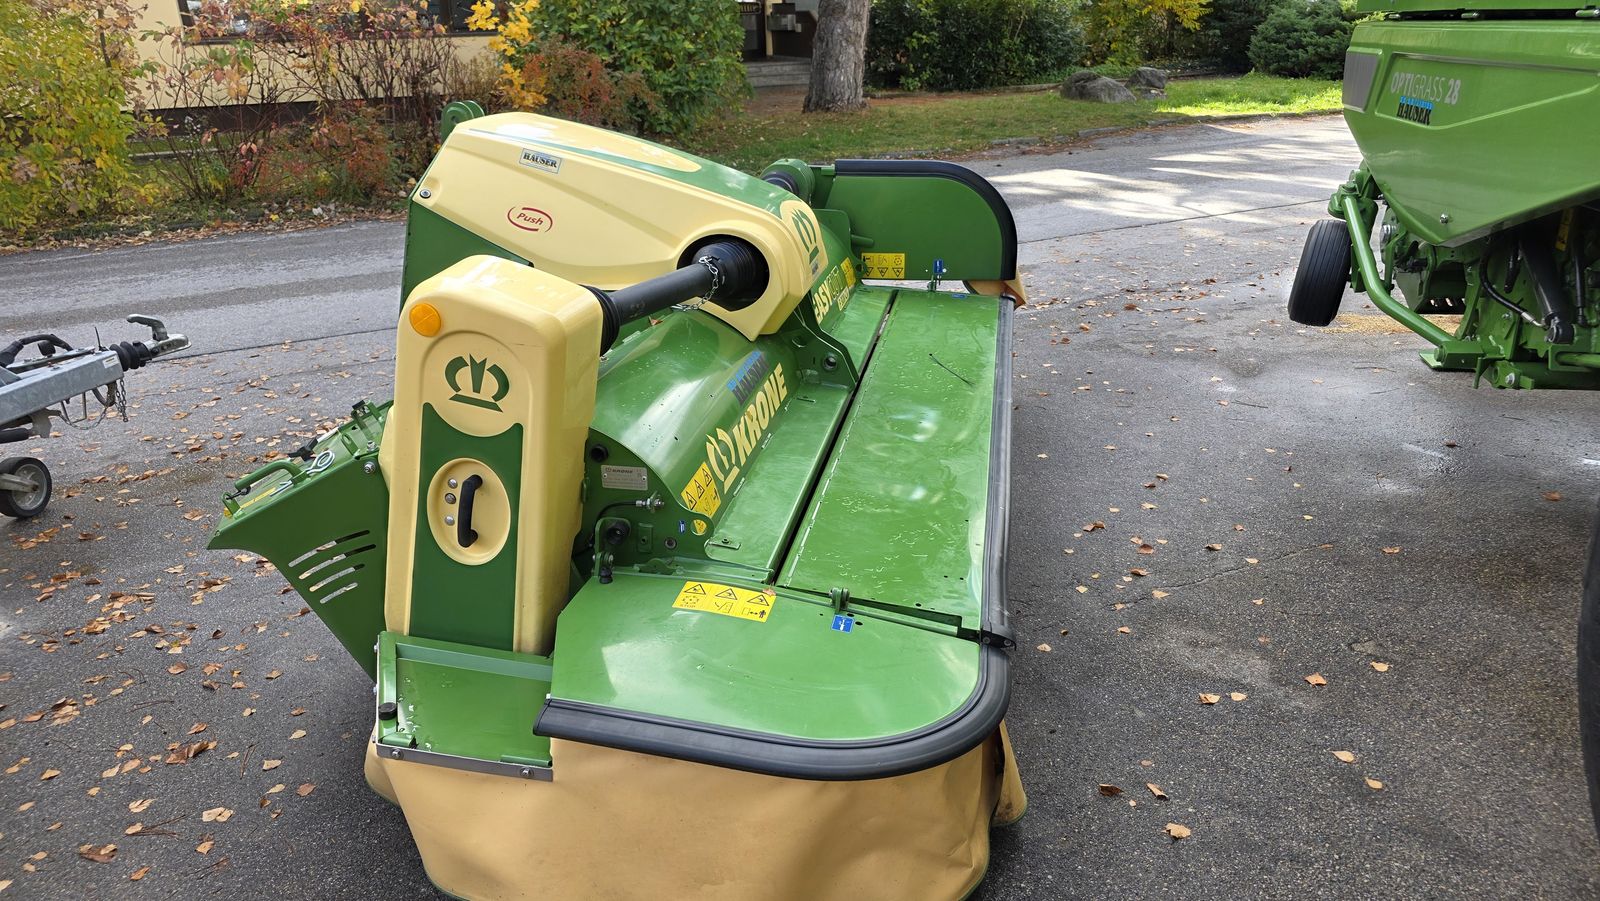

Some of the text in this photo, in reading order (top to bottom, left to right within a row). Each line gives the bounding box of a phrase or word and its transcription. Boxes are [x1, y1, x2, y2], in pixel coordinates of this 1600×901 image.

[1390, 72, 1446, 102] OPTIGRASS
[1443, 78, 1461, 105] 28
[523, 152, 558, 168] HAUSER
[516, 212, 544, 226] Push
[732, 362, 788, 467] KRONE
